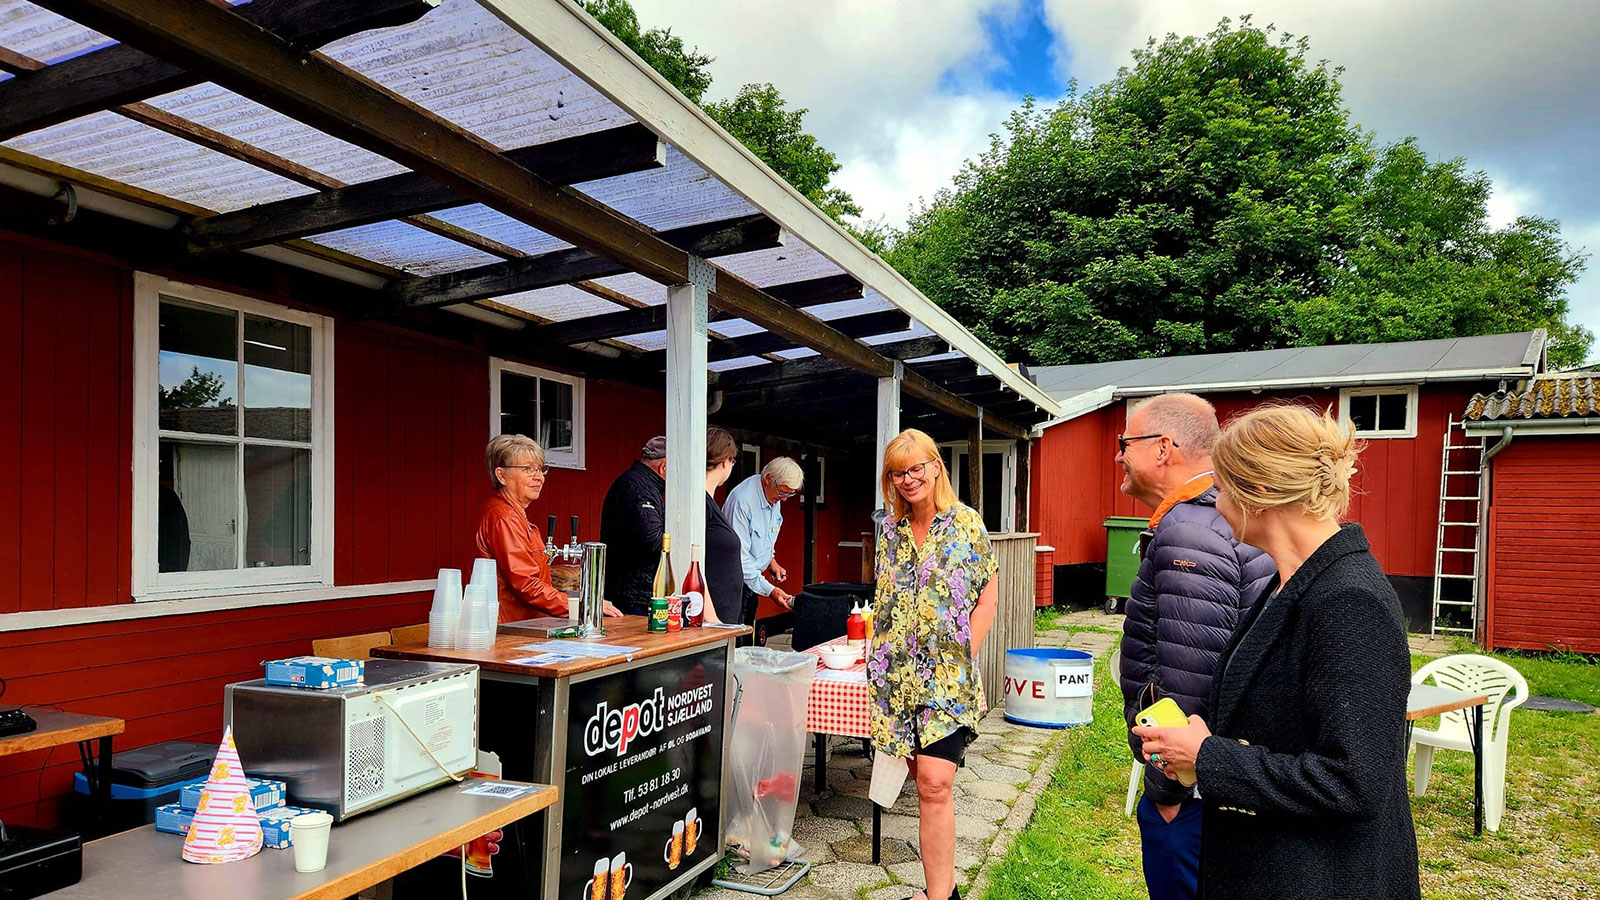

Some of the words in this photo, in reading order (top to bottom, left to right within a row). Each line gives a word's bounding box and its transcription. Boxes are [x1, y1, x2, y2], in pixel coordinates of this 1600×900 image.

[1059, 674, 1090, 685] PANT
[667, 683, 714, 711] NORDVEST
[583, 686, 665, 757] depot
[667, 699, 714, 727] SJÆLLAND
[581, 771, 594, 785] DIN
[594, 762, 618, 780] LOKALE
[619, 747, 657, 770] LEVERANDØR
[658, 742, 668, 754] AF
[667, 741, 676, 750] ØL
[676, 737, 685, 746] OG
[685, 724, 712, 743] SODAVAND
[637, 782, 649, 798] 53
[649, 777, 659, 792] 81
[660, 771, 671, 787] 18
[671, 767, 681, 781] 30
